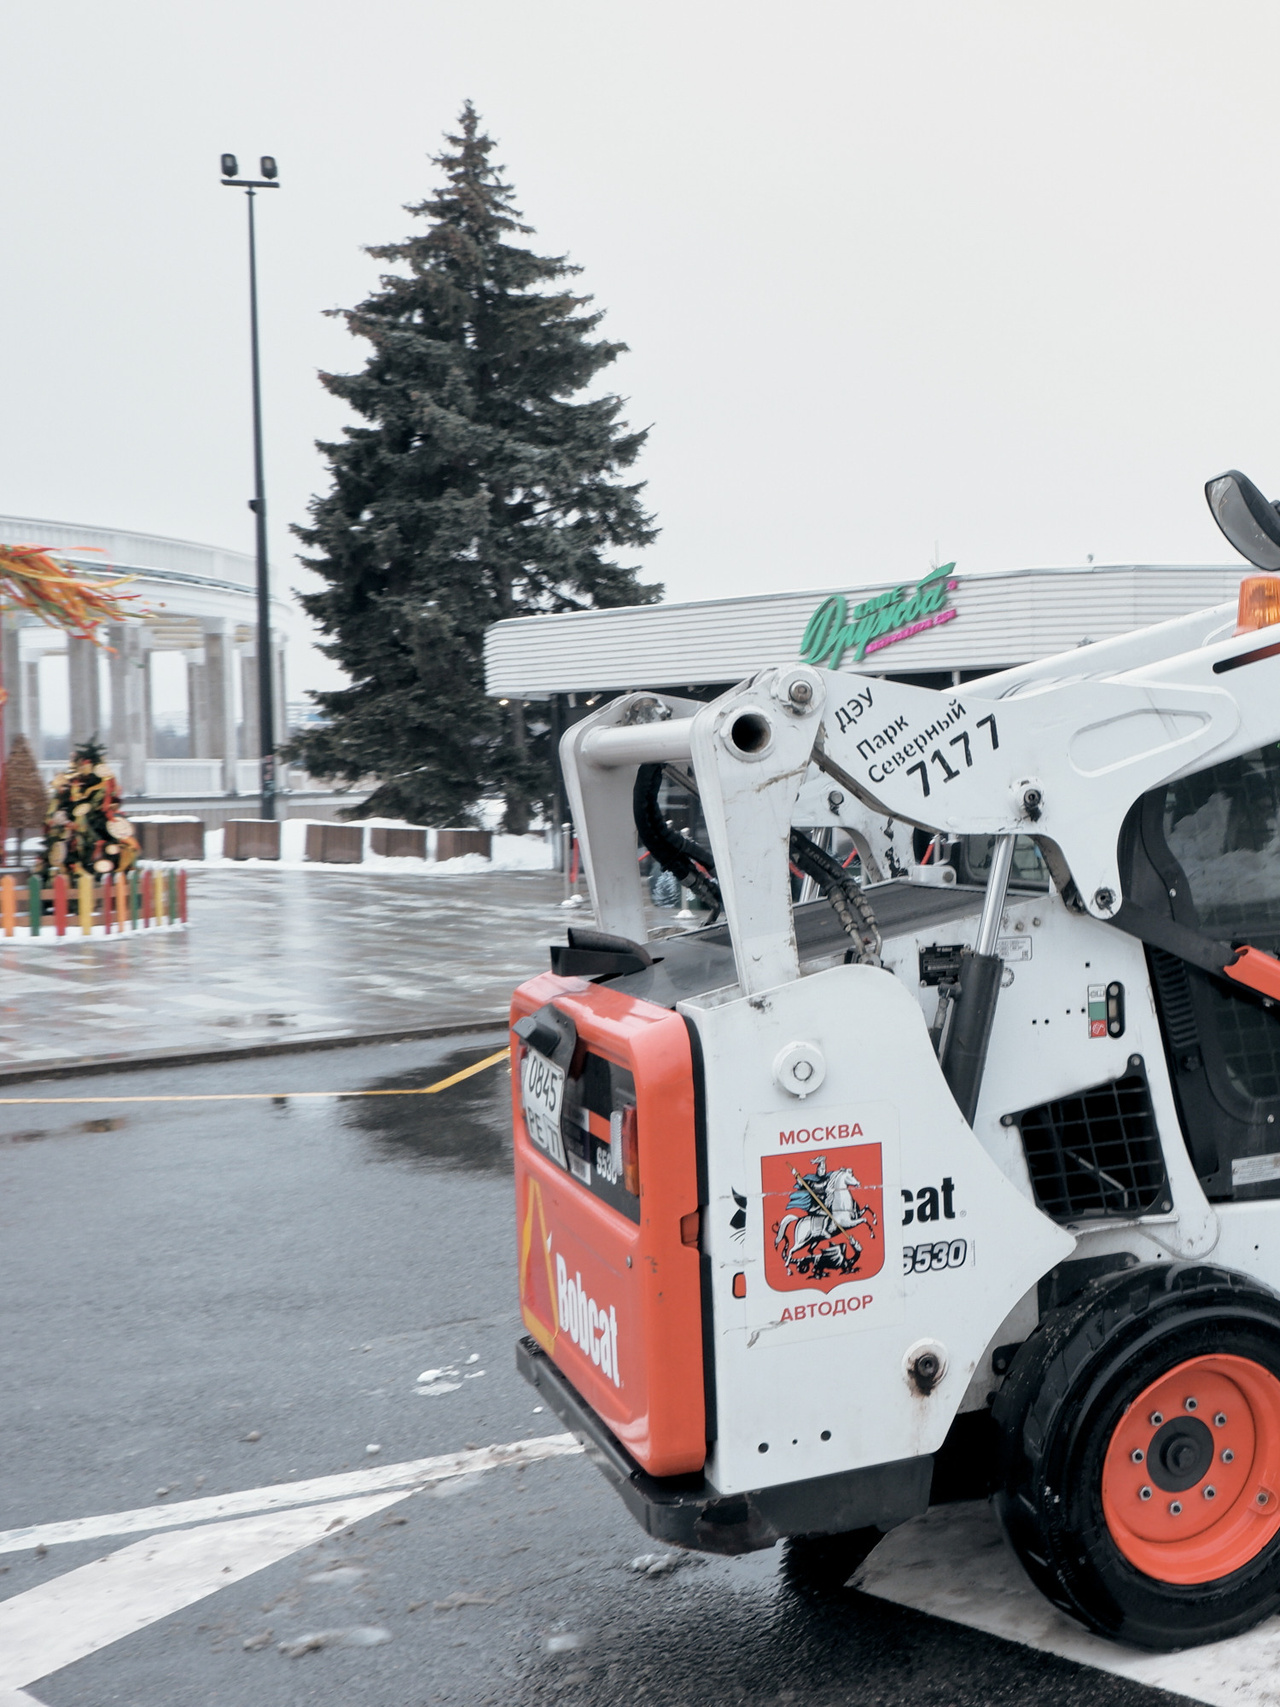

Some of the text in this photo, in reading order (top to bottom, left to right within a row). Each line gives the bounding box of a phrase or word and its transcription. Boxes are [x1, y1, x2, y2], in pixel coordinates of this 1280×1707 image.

[834, 686, 874, 734] ДЭУ
[856, 714, 910, 761] Парк
[868, 698, 967, 784] Северный
[906, 713, 1000, 798] 7177
[528, 1055, 558, 1113] 0845
[778, 1121, 864, 1146] МОСКВА
[556, 1252, 621, 1389] Bobcat
[779, 1293, 874, 1322] АВТОДОР
